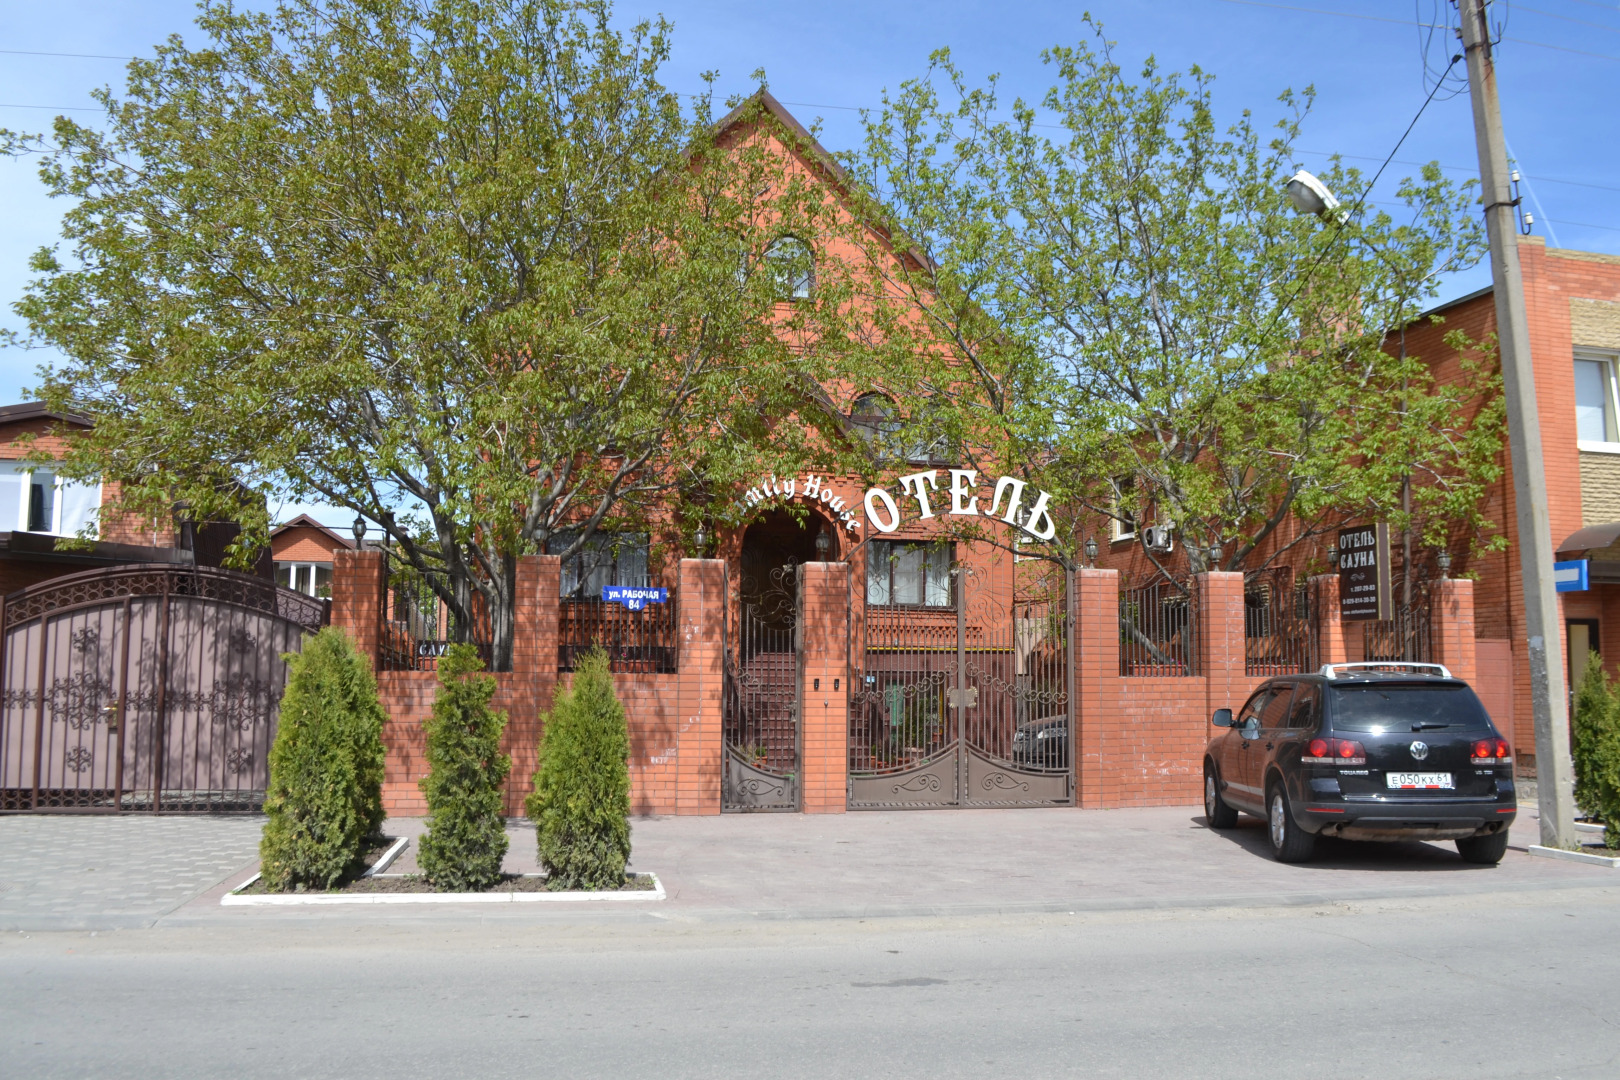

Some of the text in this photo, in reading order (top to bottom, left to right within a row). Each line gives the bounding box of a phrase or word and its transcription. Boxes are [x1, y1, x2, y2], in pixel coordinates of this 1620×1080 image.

[802, 474, 861, 531] House
[864, 469, 1056, 540] ОТЕЛЬ
[1340, 531, 1375, 549] ОТЕЛЬ
[1340, 550, 1375, 569] САУНА
[609, 589, 659, 600] ул. РАБОЧАЯ
[628, 600, 640, 609] 84
[419, 644, 450, 656] САУ
